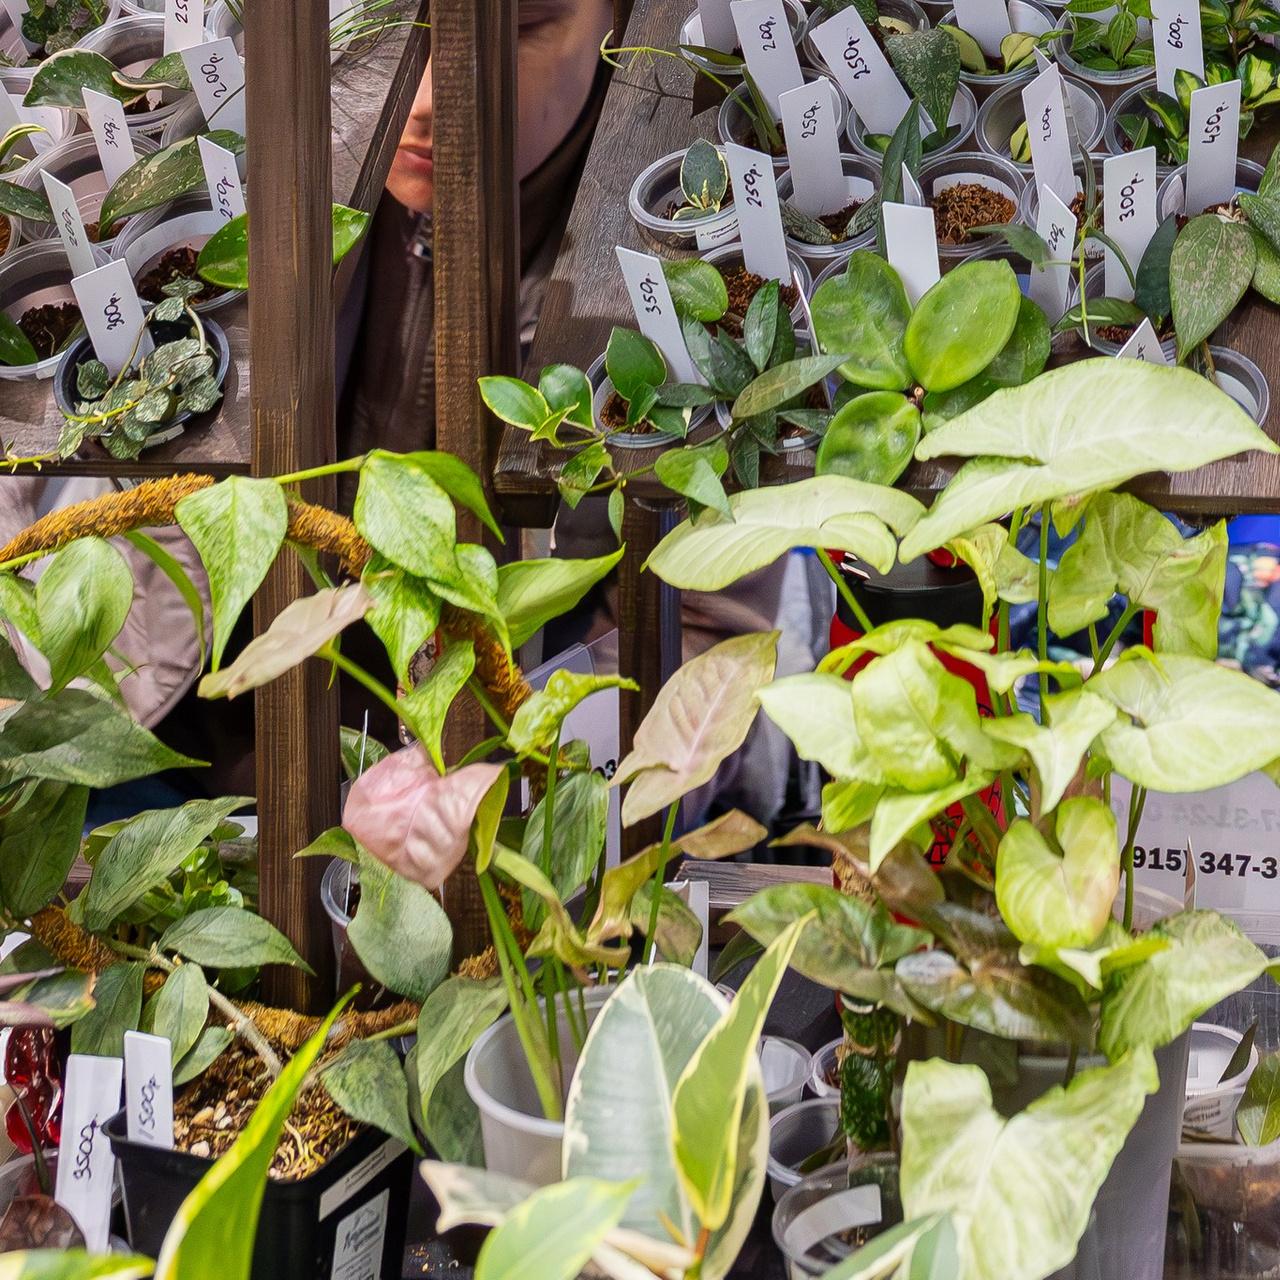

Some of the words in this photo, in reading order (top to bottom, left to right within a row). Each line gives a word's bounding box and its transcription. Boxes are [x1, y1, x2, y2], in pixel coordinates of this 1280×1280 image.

[1168, 13, 1189, 49] 600р.
[200, 52, 228, 98] 200р.
[801, 100, 822, 139] 250р.
[1201, 101, 1230, 145] 450р.
[743, 163, 764, 209] 250р.
[1118, 172, 1145, 223] 300р.
[640, 272, 661, 316] 350р.
